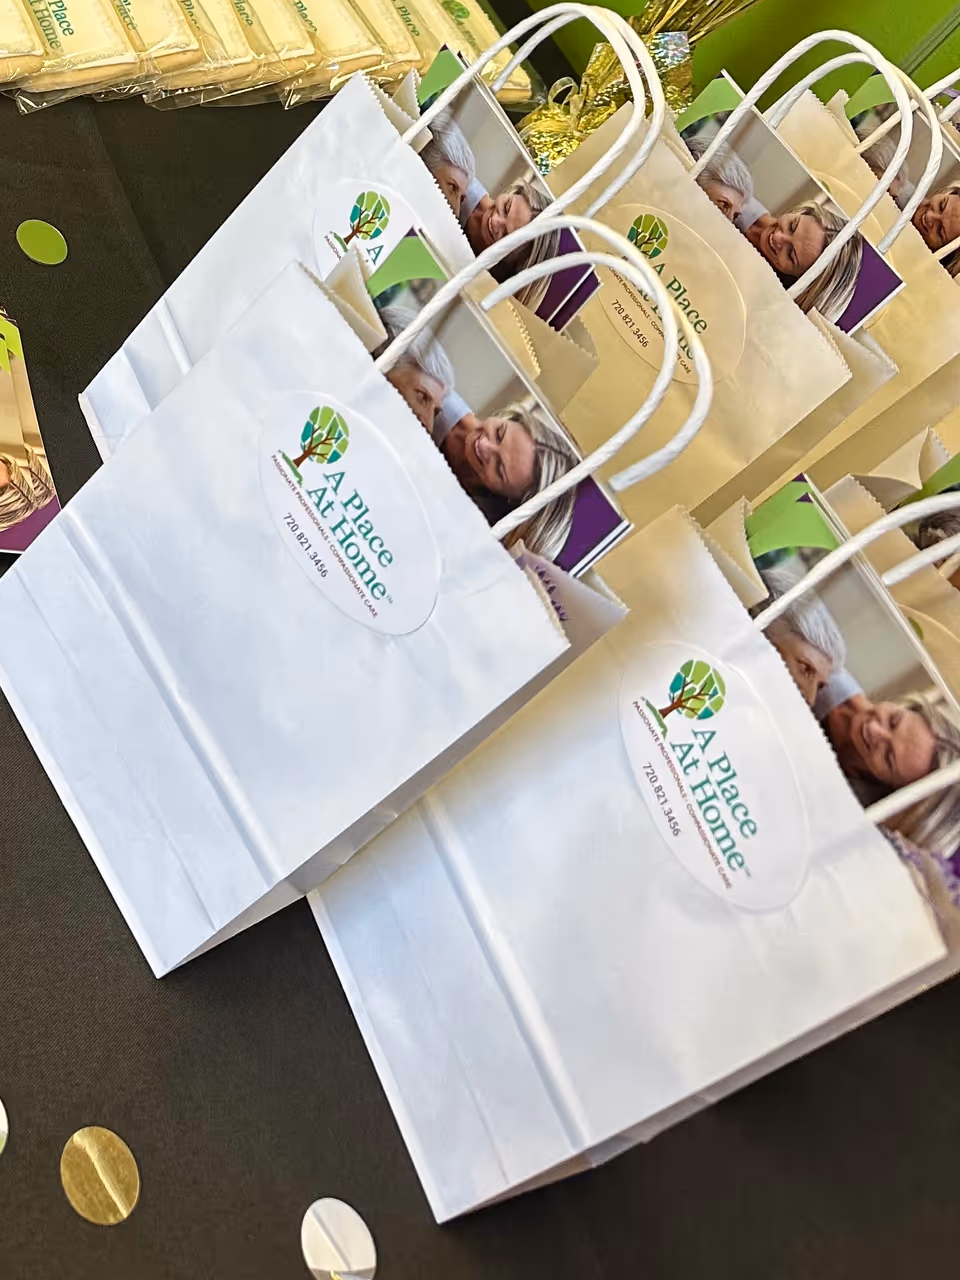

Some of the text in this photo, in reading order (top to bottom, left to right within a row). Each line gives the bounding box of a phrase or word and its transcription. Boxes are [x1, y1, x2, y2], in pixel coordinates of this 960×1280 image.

[32, 6, 59, 49] Home
[396, 5, 419, 36] Place
[323, 235, 341, 260] PASSIONA
[366, 244, 384, 266] A
[611, 298, 648, 347] 720.821.3456
[665, 275, 707, 333] Place
[305, 486, 334, 518] At
[323, 471, 393, 567] A Place
[271, 454, 377, 617] PASSIONATE PROFESSIONALS COMPASSIONATE CARE
[283, 512, 327, 577] 720.821.3456
[632, 700, 660, 742] PASSIONATE
[657, 742, 686, 798] PROFESSIONALS
[669, 742, 699, 775] At
[642, 762, 681, 836] 720.821.3456
[691, 729, 756, 838] A Place
